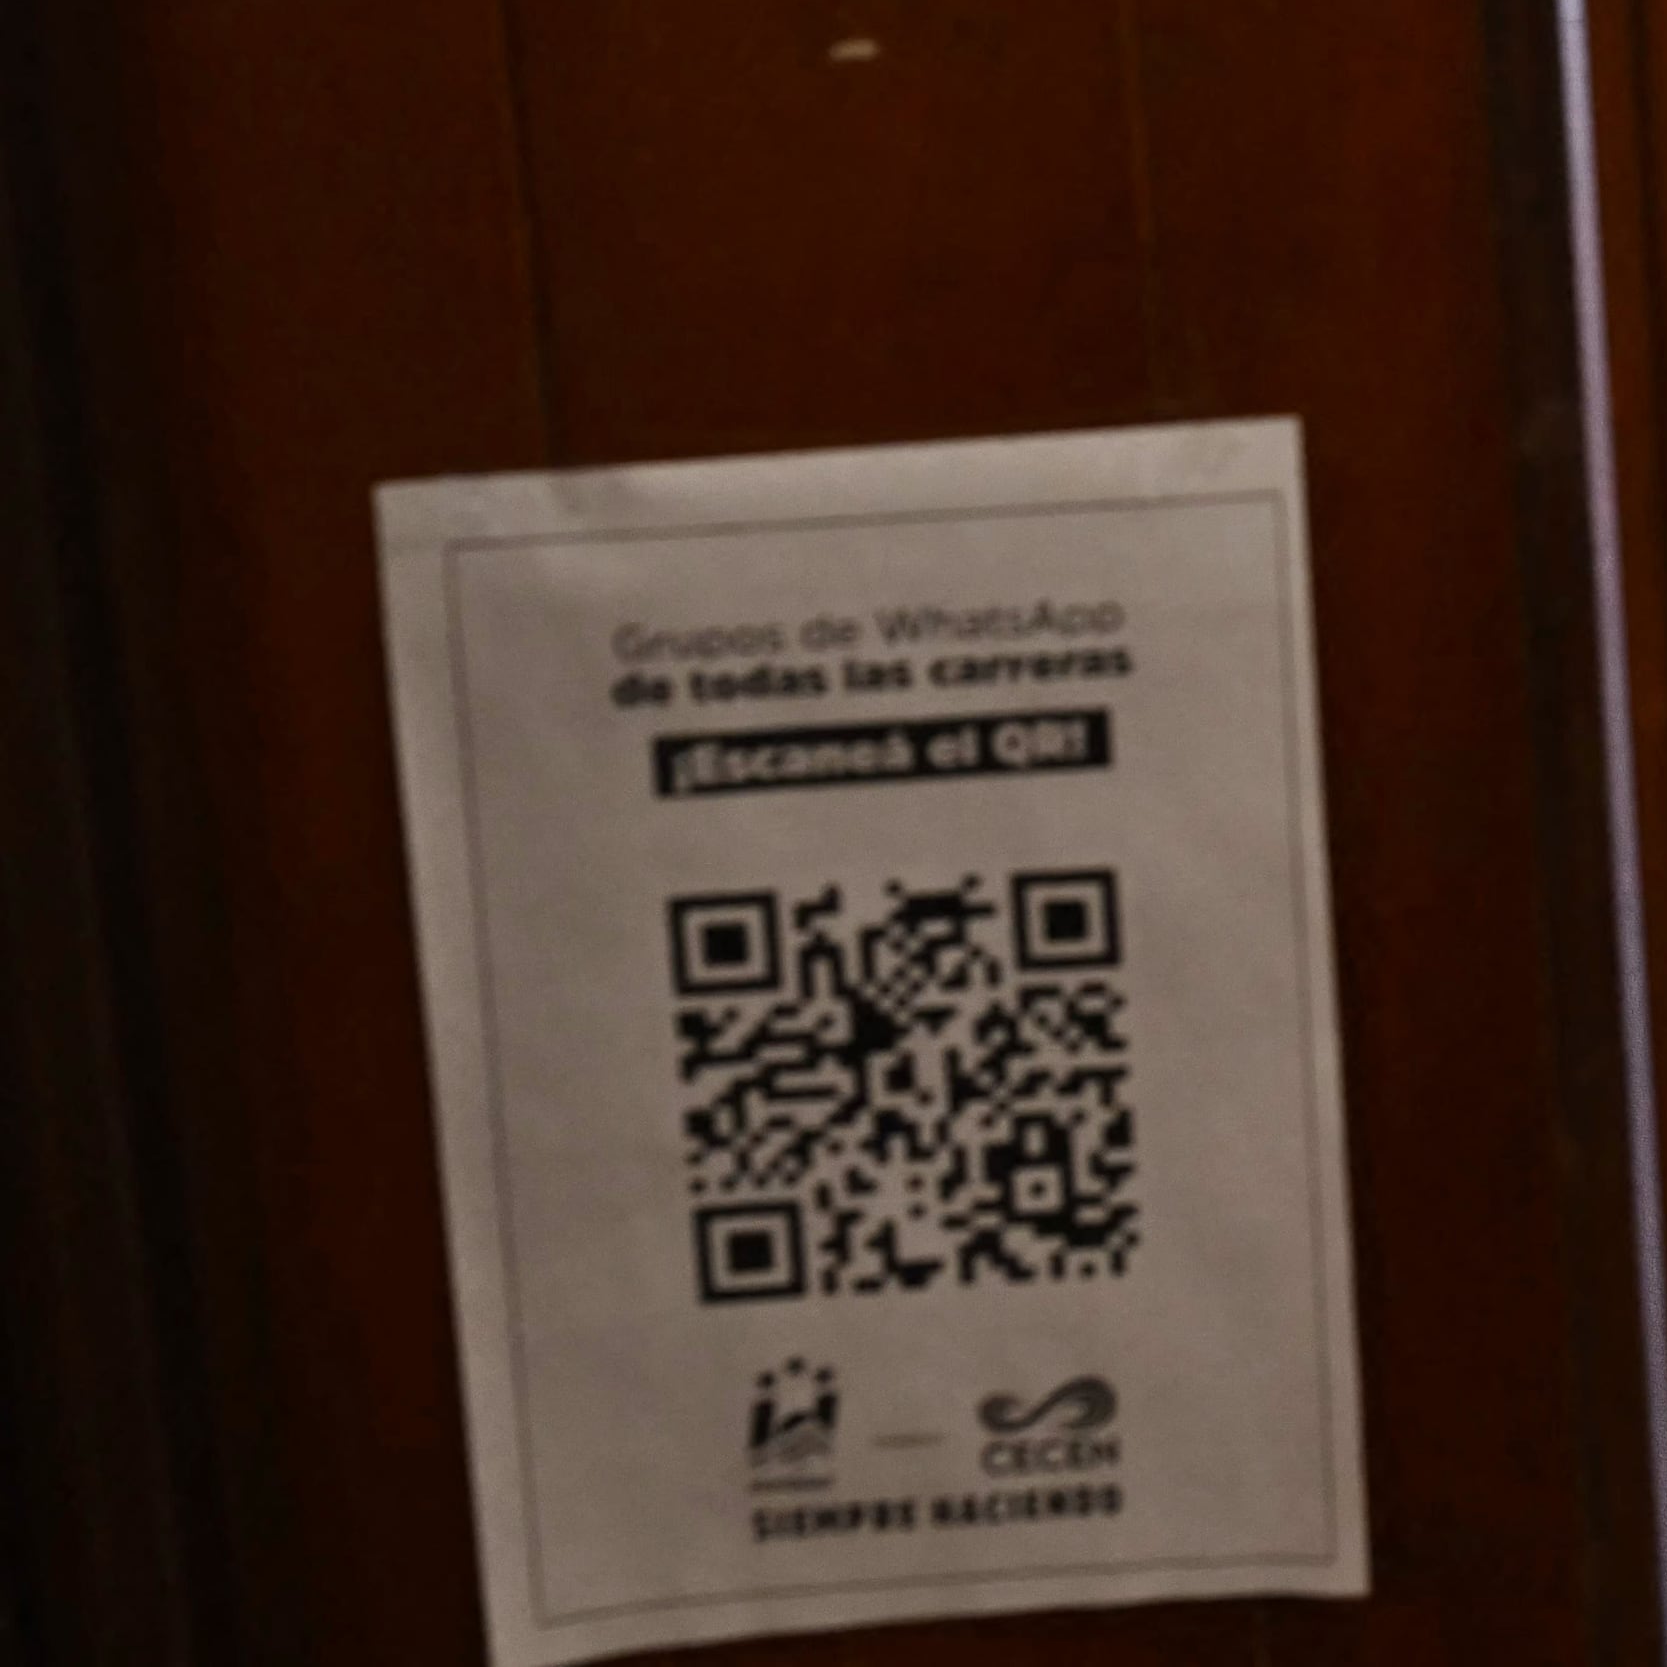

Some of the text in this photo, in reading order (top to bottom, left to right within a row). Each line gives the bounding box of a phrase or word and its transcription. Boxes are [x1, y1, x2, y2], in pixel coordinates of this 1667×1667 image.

[611, 598, 1127, 664] Grupos de WhatsApp
[611, 647, 1134, 710] de todas las carreras
[925, 729, 979, 768] el
